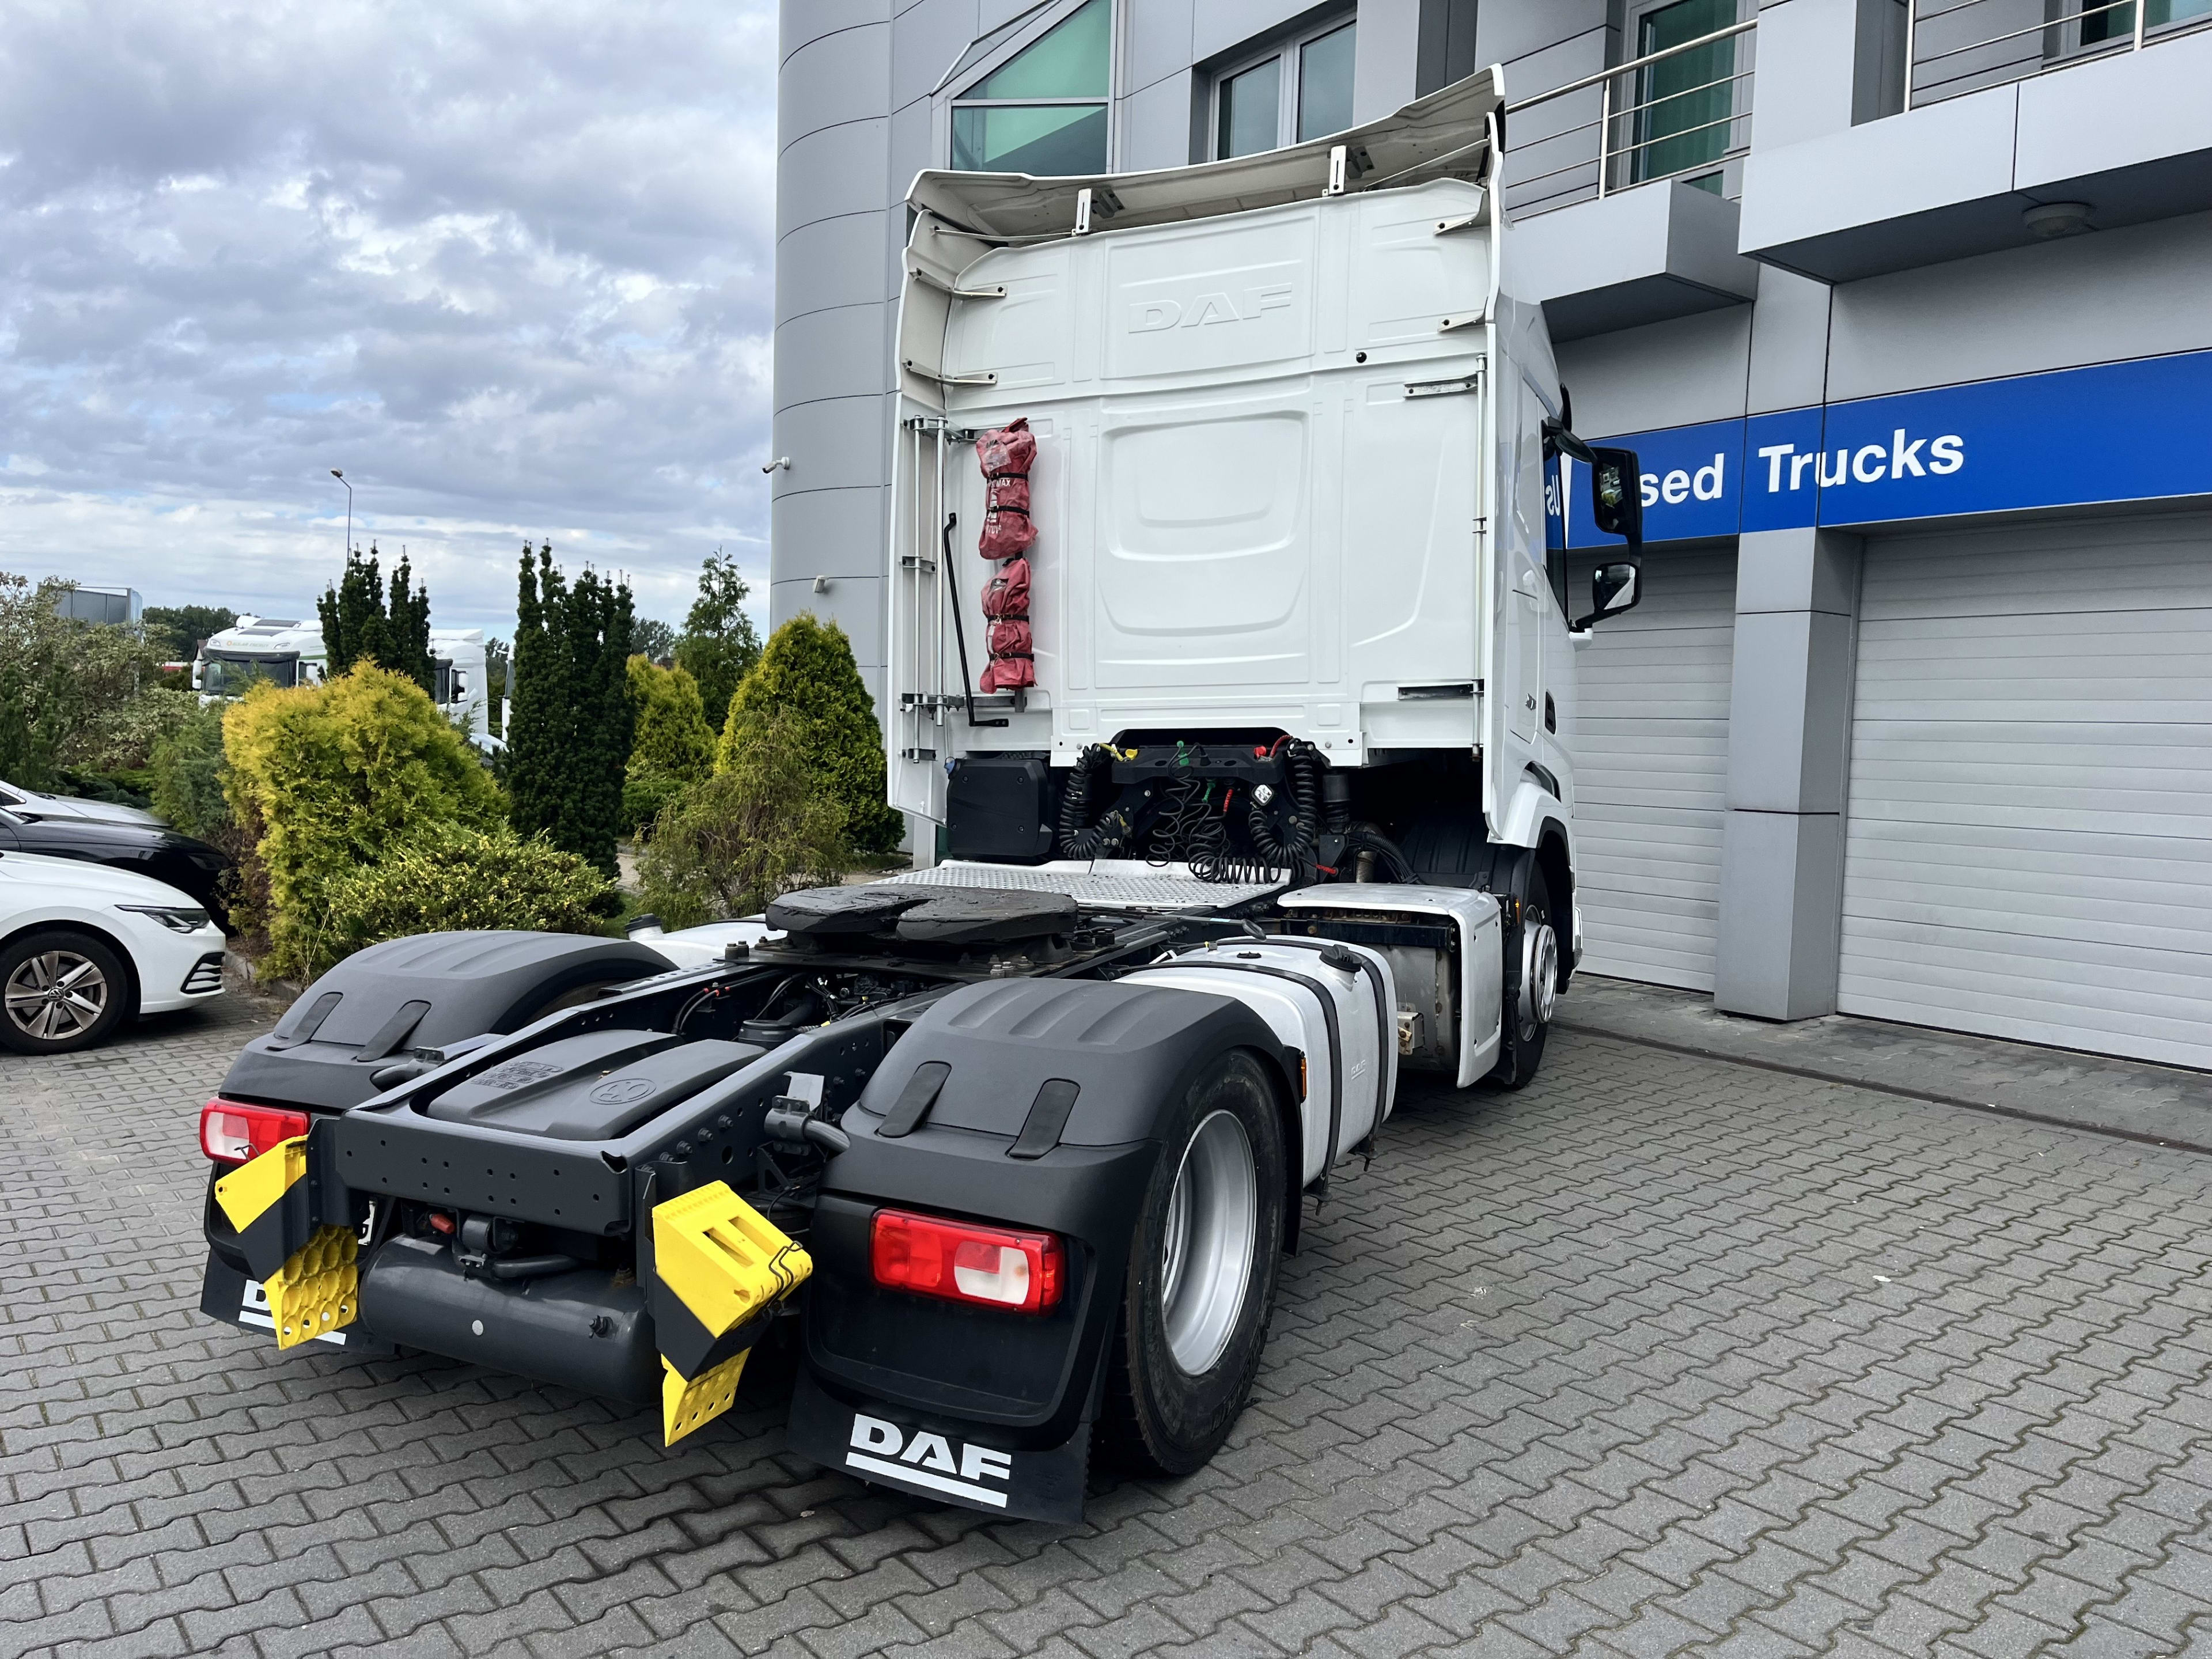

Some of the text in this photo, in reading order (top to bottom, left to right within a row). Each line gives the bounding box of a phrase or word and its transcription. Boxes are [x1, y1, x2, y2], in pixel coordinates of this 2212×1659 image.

[1128, 282, 1292, 334] DAF
[1639, 428, 1964, 507] sed Trucks
[850, 1413, 1012, 1480] DAF
